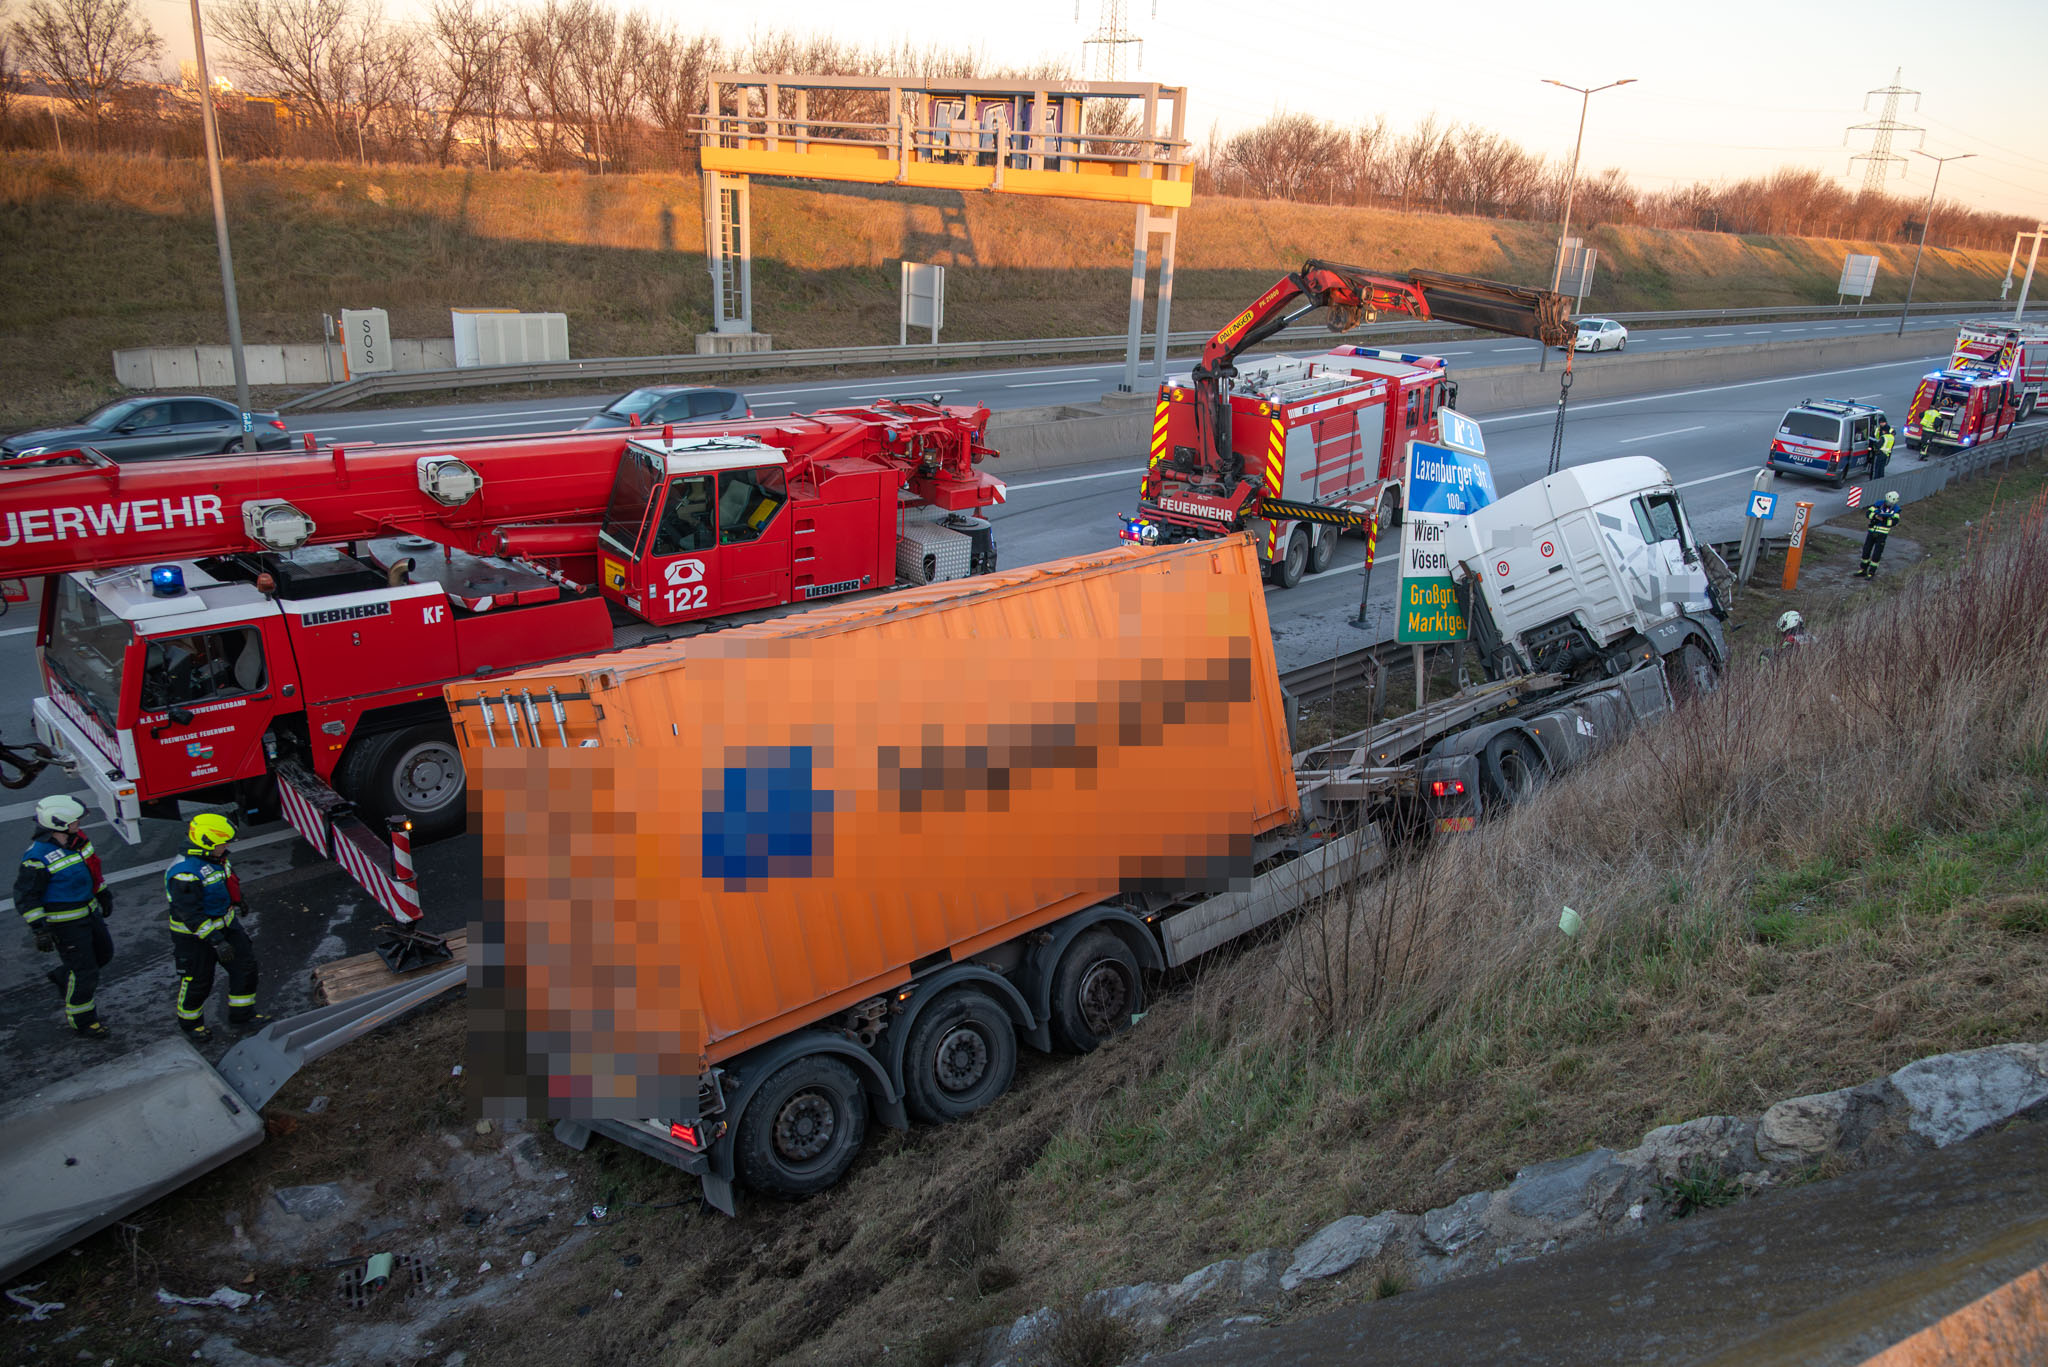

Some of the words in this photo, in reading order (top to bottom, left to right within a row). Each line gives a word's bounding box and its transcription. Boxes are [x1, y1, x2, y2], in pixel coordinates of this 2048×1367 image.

[1219, 312, 1252, 342] PALFINGER
[362, 319, 374, 364] SOS
[1467, 425, 1475, 446] 3
[1788, 454, 1814, 464] POLIZEI
[1415, 451, 1473, 492] Laxenburger
[1473, 463, 1491, 489] Str.
[1159, 497, 1233, 522] FEUERWEHR
[1414, 519, 1450, 542] Wien-
[1791, 508, 1805, 546] SOS
[663, 584, 708, 613] 122
[806, 580, 860, 598] LIEBHERR
[302, 603, 390, 627] LIEBHERR
[423, 605, 444, 625] KF
[160, 732, 198, 746] FREIWILLIGE
[199, 725, 236, 738] FEUERWEHR
[190, 766, 218, 778] MÖDLING
